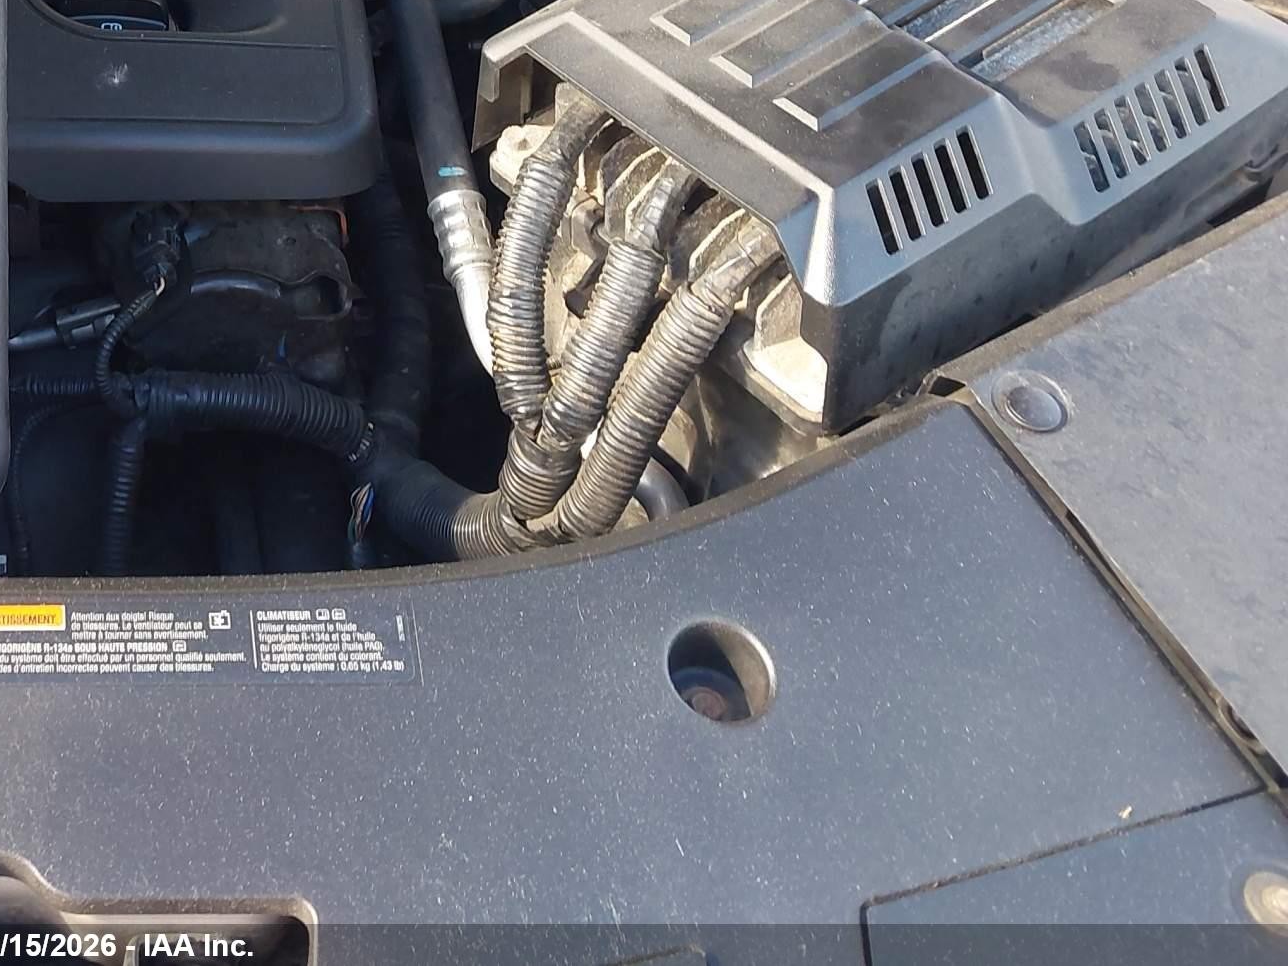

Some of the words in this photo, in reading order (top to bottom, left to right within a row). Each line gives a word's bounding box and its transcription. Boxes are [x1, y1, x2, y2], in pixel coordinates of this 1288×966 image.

[71, 612, 104, 621] Attention
[106, 612, 119, 621] aux
[149, 612, 174, 621] Risque
[257, 611, 311, 620] CLIMATISEUR
[71, 621, 81, 631] de
[83, 621, 120, 631] blessures.
[122, 621, 132, 631] Le
[133, 621, 173, 631] ventilateur
[175, 621, 191, 631] peut
[193, 621, 203, 631] se
[258, 622, 284, 632] Utiliser
[286, 622, 326, 632] seulement
[327, 622, 334, 632] le
[336, 622, 357, 632] fluide
[72, 631, 96, 640] mettre
[105, 631, 132, 640] tourner
[134, 631, 152, 640] sans
[301, 633, 330, 642] R-134a
[331, 633, 339, 642] et
[341, 633, 351, 642] de
[43, 642, 72, 653] R-134a
[74, 642, 97, 653] SOUS
[98, 642, 125, 653] HAUTE
[127, 642, 168, 653] PRESSION
[260, 642, 270, 652] au
[0, 653, 9, 663] du
[44, 653, 59, 663] doit
[110, 653, 123, 663] par
[125, 653, 135, 663] un
[136, 653, 173, 663] personnel
[261, 652, 271, 662] Le
[306, 652, 337, 662] contient
[339, 652, 348, 662] du
[350, 652, 383, 662] colorant.
[56, 664, 99, 673] incorrectes
[100, 664, 130, 673] peuvent
[132, 664, 158, 673] causer
[159, 664, 173, 673] des
[175, 664, 214, 673] blessures.
[262, 662, 289, 672] Charge
[291, 662, 301, 672] du
[360, 661, 371, 672] kg
[394, 661, 405, 671] lb)
